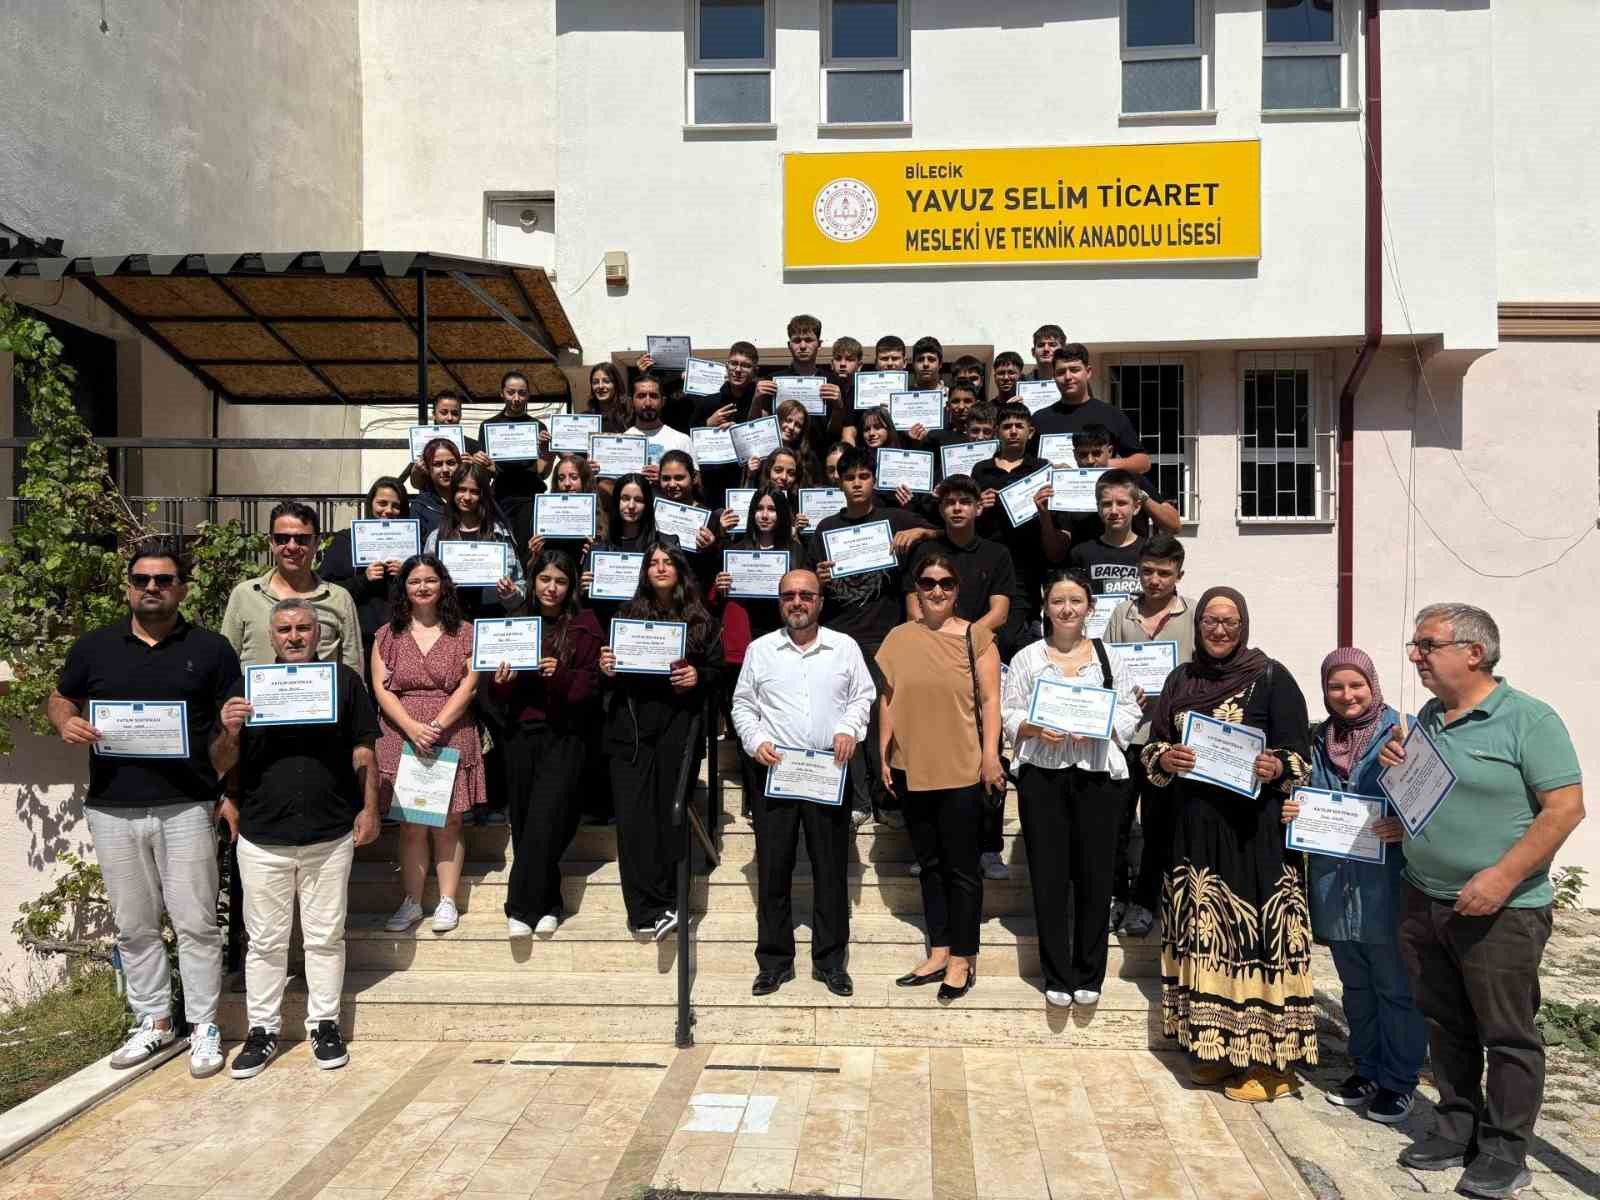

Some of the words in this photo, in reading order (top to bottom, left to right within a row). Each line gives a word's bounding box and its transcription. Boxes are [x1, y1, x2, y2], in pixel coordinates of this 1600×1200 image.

[905, 161, 963, 179] BİLECİK
[905, 188, 994, 212] YAVUZ
[1004, 180, 1088, 210] SELİM
[1097, 178, 1220, 208] TİCARET
[905, 221, 980, 251] MESLEKİ
[985, 227, 1006, 250] VE
[1011, 220, 1076, 250] TEKNİK
[1079, 223, 1163, 248] ANADOLU
[1167, 216, 1221, 246] LİSESİ
